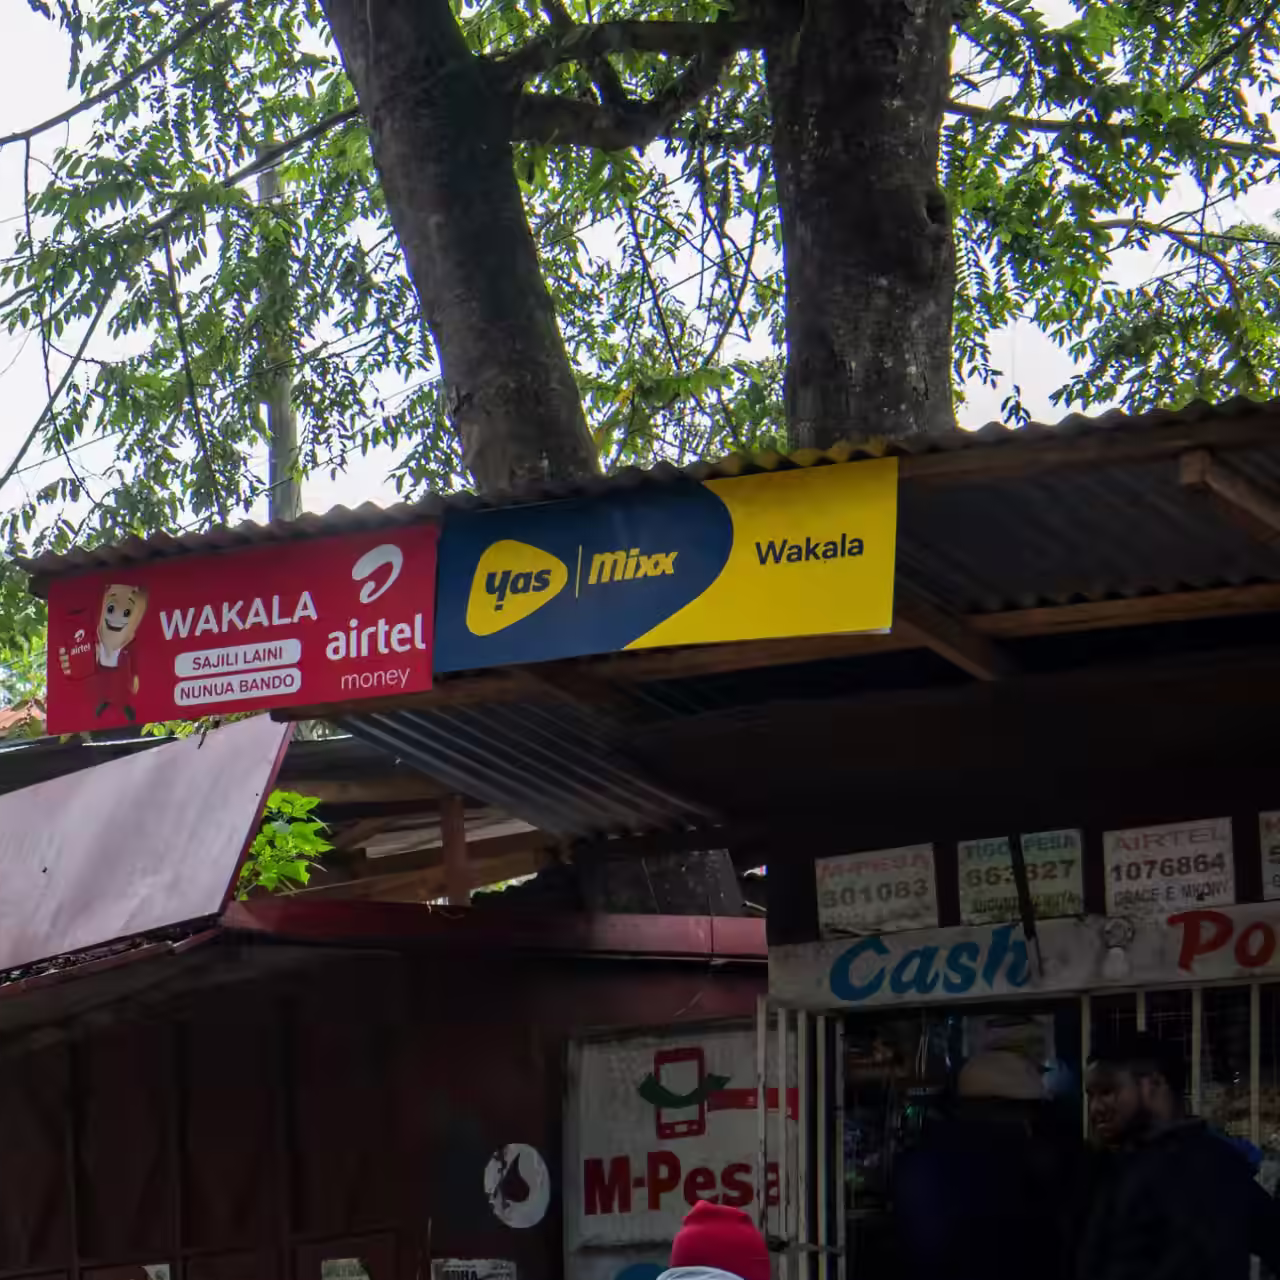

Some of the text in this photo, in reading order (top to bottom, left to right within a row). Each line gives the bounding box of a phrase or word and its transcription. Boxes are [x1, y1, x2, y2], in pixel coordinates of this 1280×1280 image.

[755, 533, 864, 566] Wakala
[159, 590, 318, 641] WAKALA
[326, 613, 426, 660] airtel
[192, 647, 283, 671] SAJILI LAINI
[180, 675, 295, 700] NUNUA BANDO
[341, 667, 411, 691] money
[1119, 827, 1227, 850] AIRTEL
[1111, 852, 1226, 882] 1076864
[829, 924, 1030, 1001] Cash
